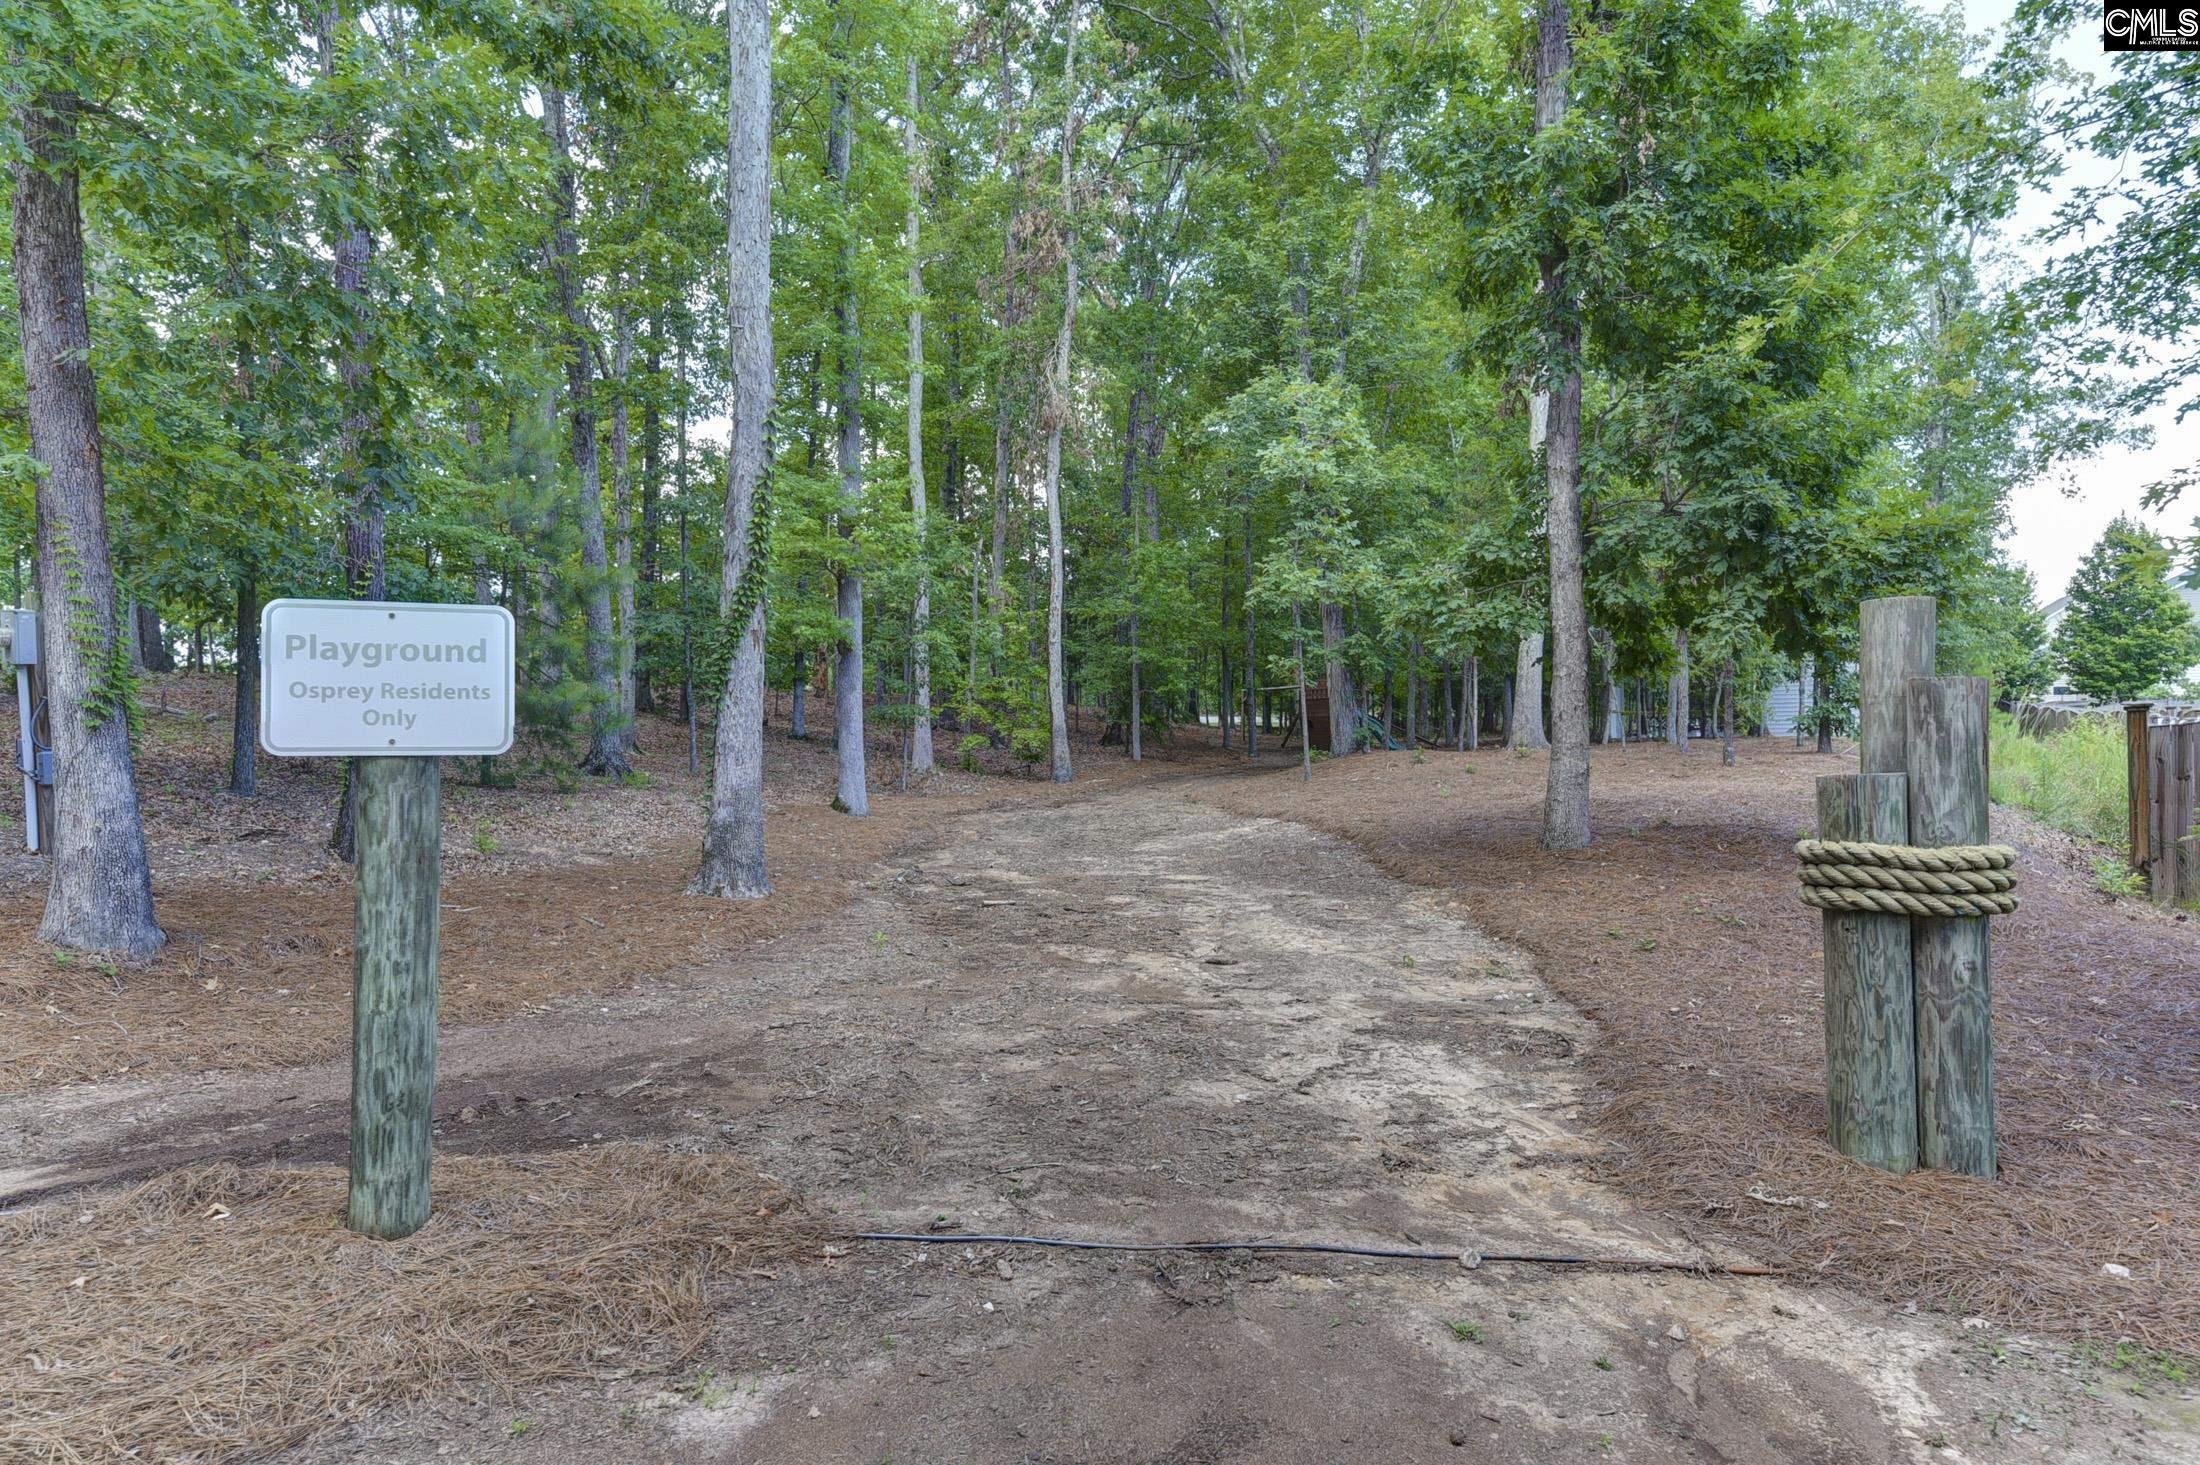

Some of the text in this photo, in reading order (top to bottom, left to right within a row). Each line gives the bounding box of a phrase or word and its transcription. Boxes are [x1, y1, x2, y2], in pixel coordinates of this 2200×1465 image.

[285, 634, 487, 668] Playground
[289, 681, 491, 703] Osprey Residents
[362, 709, 417, 730] Only
